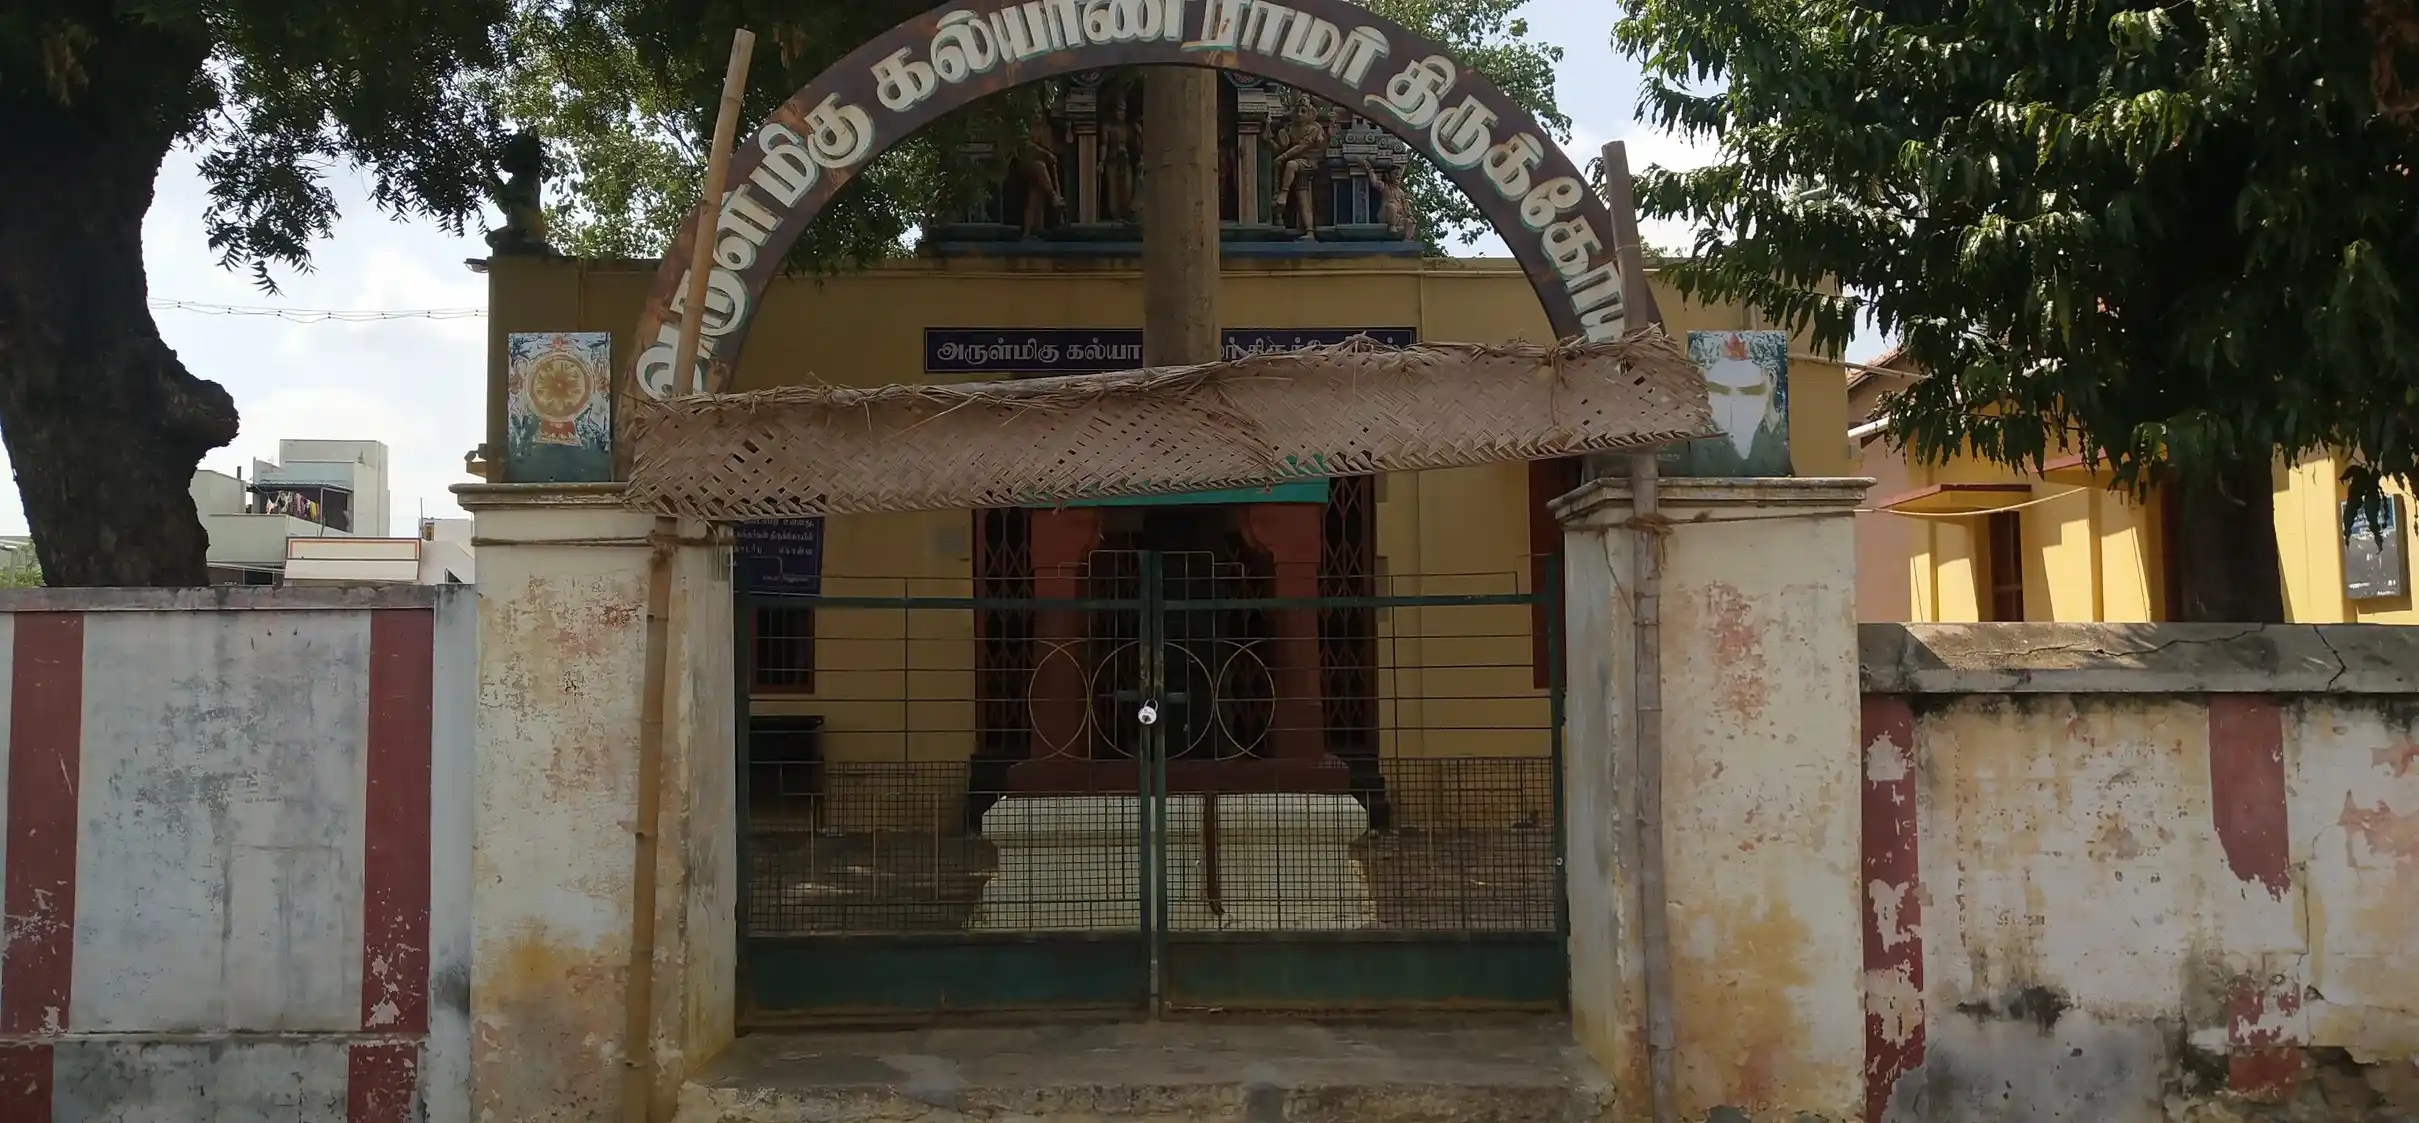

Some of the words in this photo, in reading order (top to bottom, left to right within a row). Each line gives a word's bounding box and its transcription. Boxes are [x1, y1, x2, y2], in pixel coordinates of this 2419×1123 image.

[870, 0, 1184, 112] கல்யாண
[1180, 0, 1391, 90] ராமர்
[937, 336, 1060, 365] அருள்மிகு
[1065, 336, 1142, 361] கல்யா
